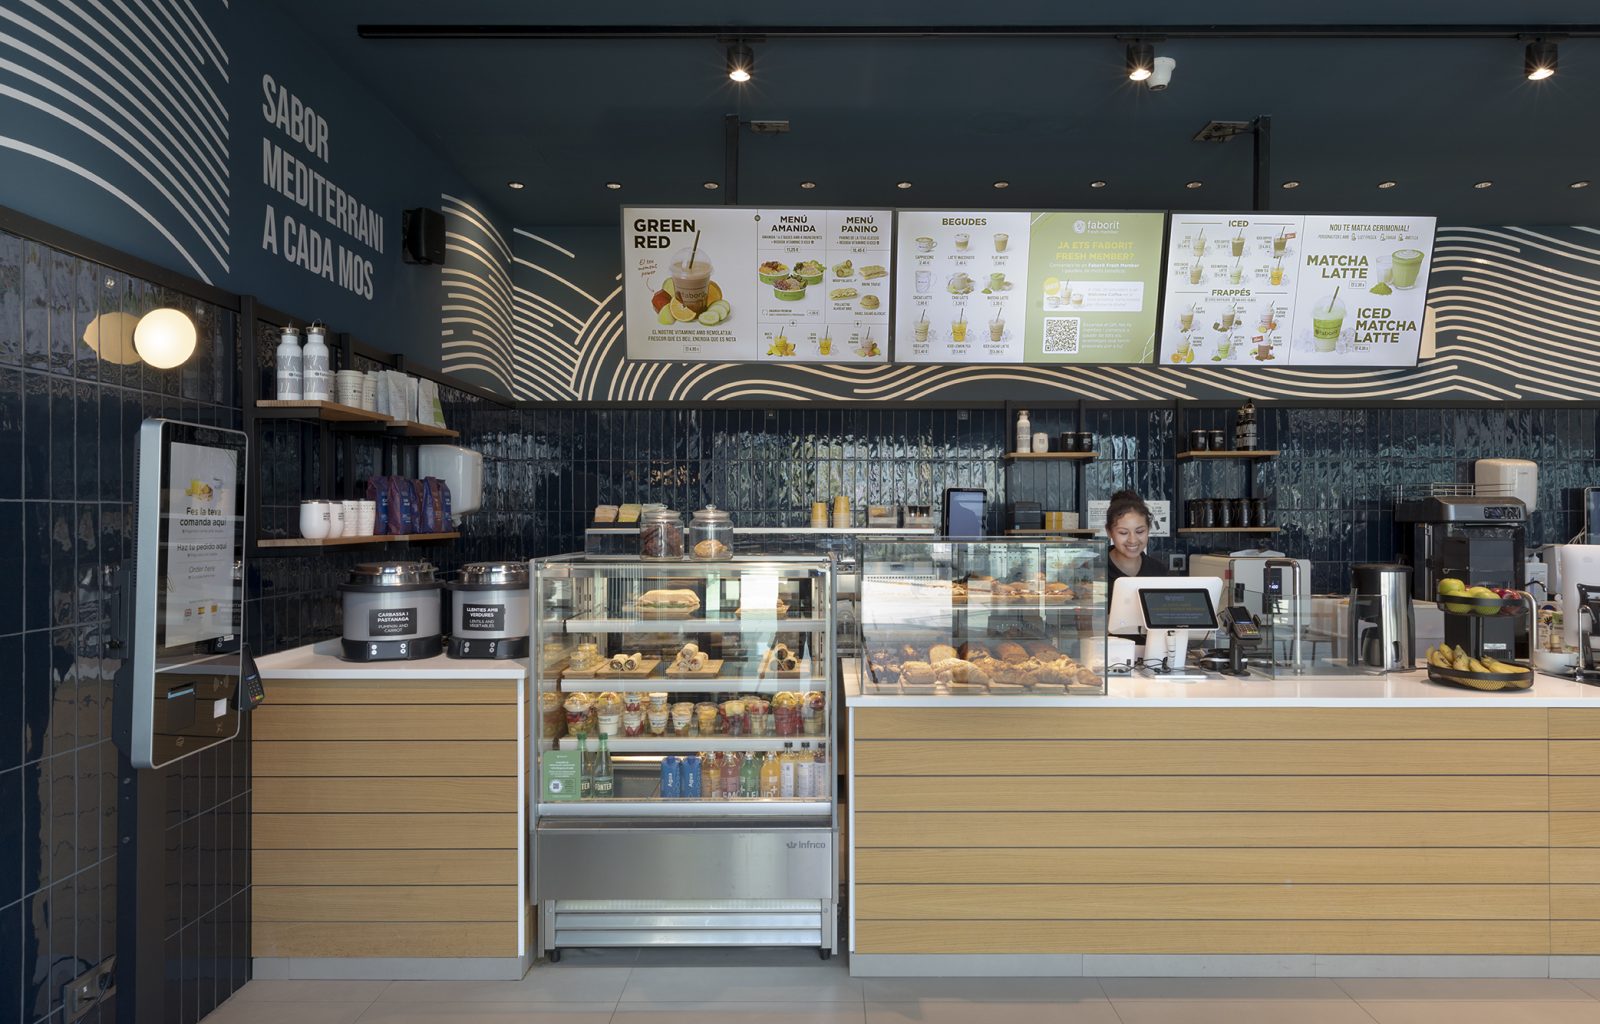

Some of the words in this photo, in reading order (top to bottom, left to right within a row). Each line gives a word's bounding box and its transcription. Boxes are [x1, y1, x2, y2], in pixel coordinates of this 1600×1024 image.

[262, 73, 329, 164] SABOR
[262, 136, 384, 255] MEDITERRANI
[780, 214, 808, 224] MENÚ
[846, 215, 874, 224] MENÚ
[942, 218, 987, 226] BEGUDES
[633, 218, 696, 233] GREEN
[771, 224, 816, 232] AMANIDA
[841, 225, 878, 233] PANINO
[1087, 219, 1120, 230] faborit
[1351, 224, 1372, 232] MATXA
[1372, 224, 1410, 232] CERIMONIAL!
[634, 235, 671, 249] RED
[1058, 241, 1070, 249] JA
[1072, 241, 1090, 249] ETS
[1092, 241, 1134, 249] FABORIT
[262, 203, 278, 256] A
[283, 214, 335, 283] CADA
[338, 244, 374, 301] MOS
[1056, 252, 1087, 260] FRESH
[1088, 252, 1136, 260] MEMBER?
[1306, 254, 1369, 267] MATCHA
[1321, 267, 1369, 279] LATTE
[1211, 288, 1251, 297] FRAPPÉS
[1357, 307, 1392, 319] ICED
[1355, 320, 1417, 332] MATCHA
[1354, 332, 1400, 343] LATTE
[187, 507, 199, 516] Fes
[207, 507, 222, 516] teva
[179, 519, 211, 527] comanda
[177, 544, 188, 552] Haz
[196, 542, 216, 551] pedido
